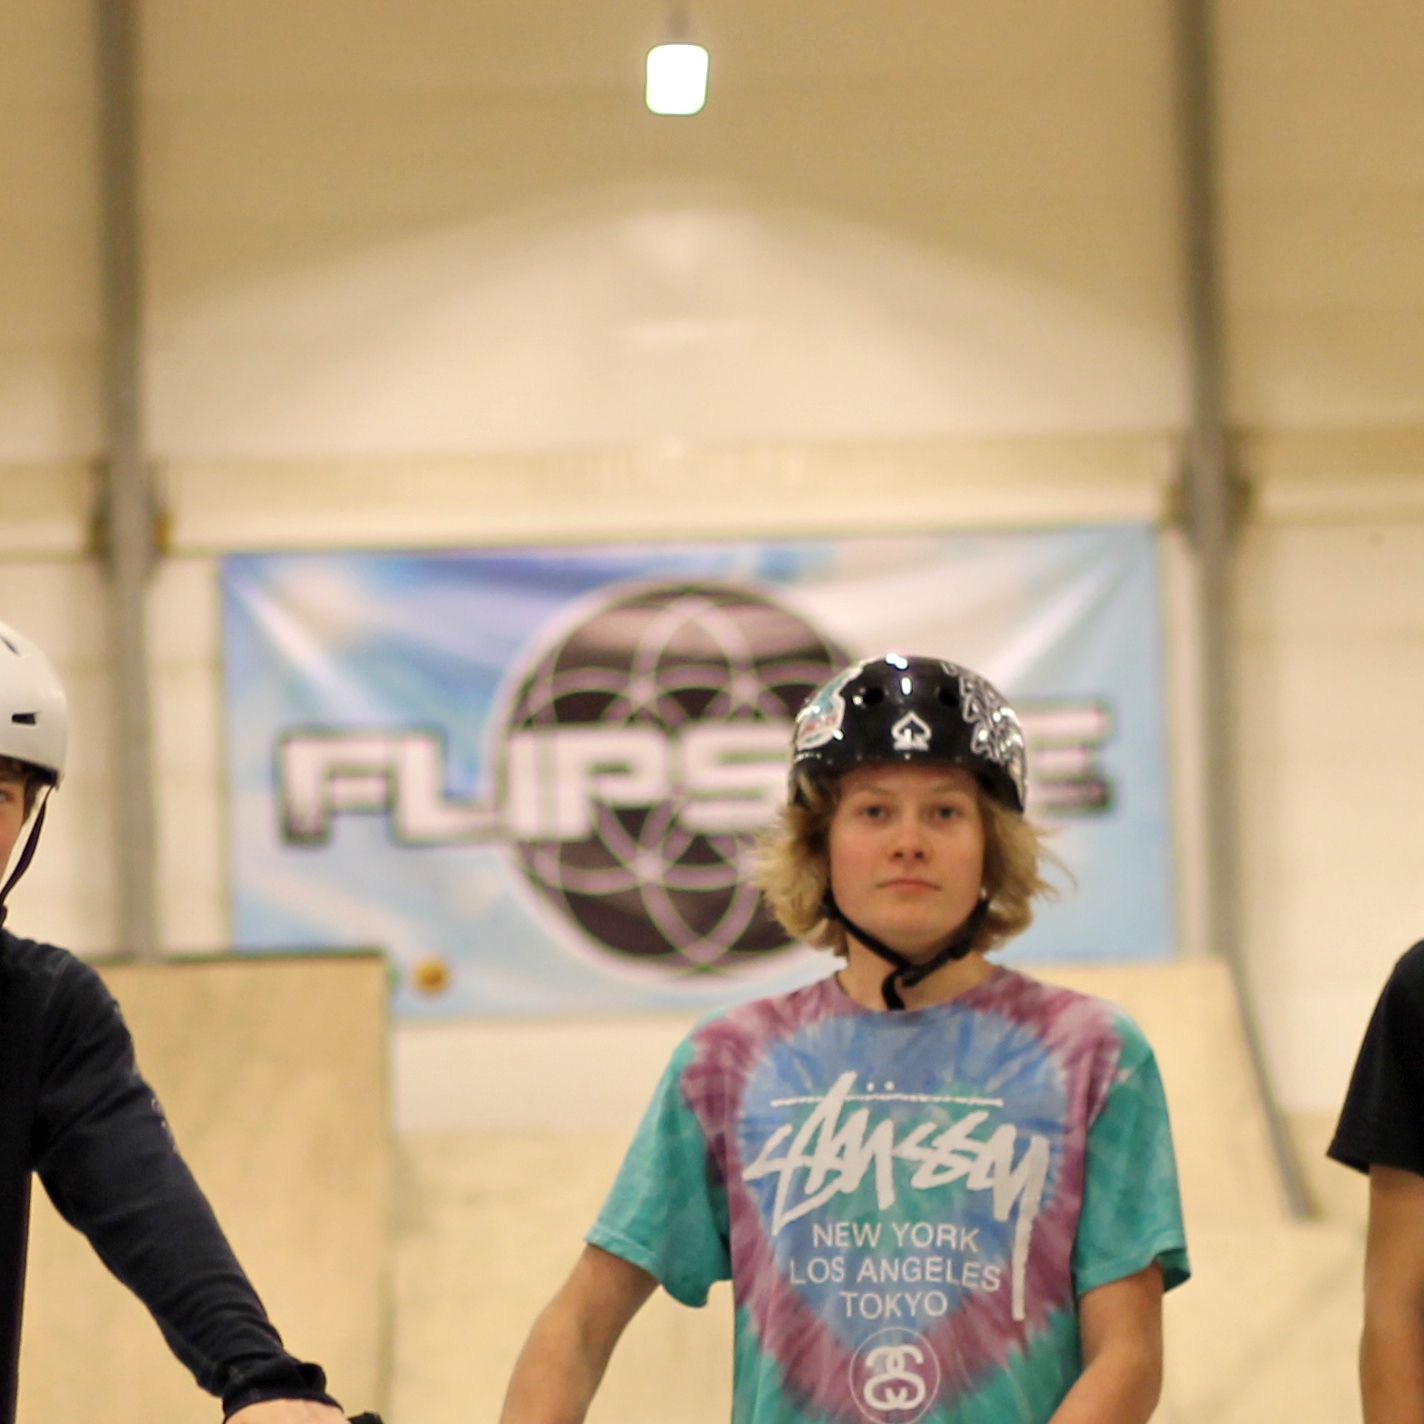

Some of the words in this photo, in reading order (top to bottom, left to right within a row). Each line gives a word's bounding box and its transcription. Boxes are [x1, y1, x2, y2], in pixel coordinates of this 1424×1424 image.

[811, 1222, 881, 1249] NEW
[891, 1222, 980, 1253] YORK
[788, 1256, 846, 1286] LOS
[857, 1256, 1003, 1293] ANGELES
[839, 1290, 949, 1319] TOKYO
